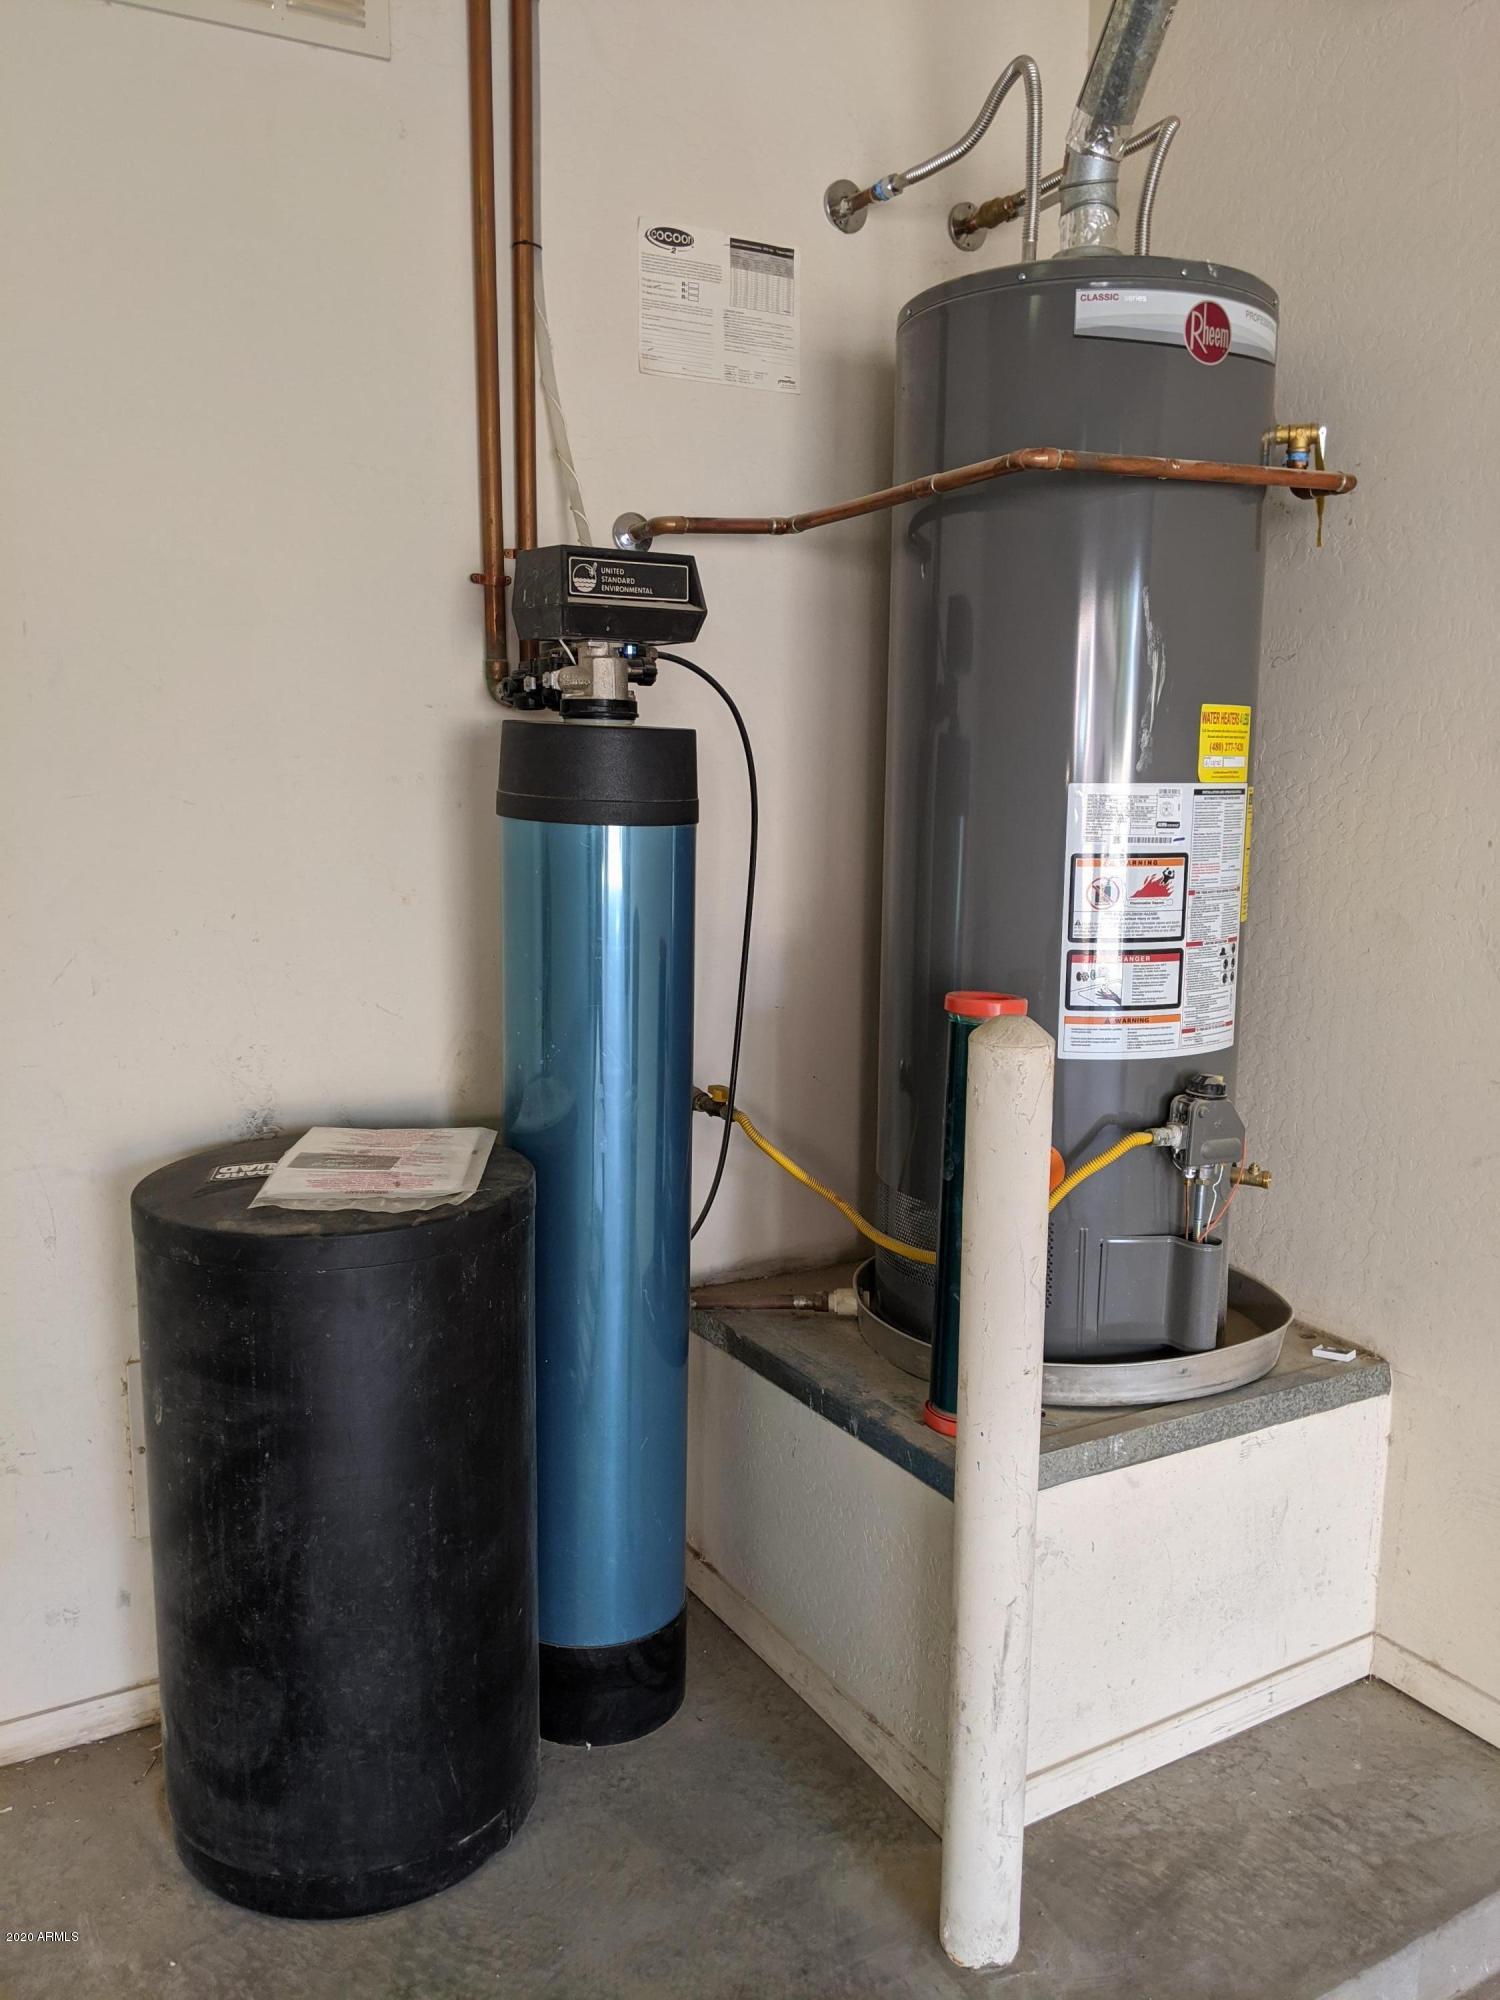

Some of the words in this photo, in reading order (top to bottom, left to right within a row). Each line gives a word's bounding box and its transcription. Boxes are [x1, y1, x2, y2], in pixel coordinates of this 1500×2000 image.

[1080, 293, 1120, 302] CLASSIC
[1190, 303, 1230, 353] Rheem
[601, 567, 625, 575] UNITED
[601, 575, 636, 585] STANDARD
[601, 584, 654, 595] ENVIRONMENTAL
